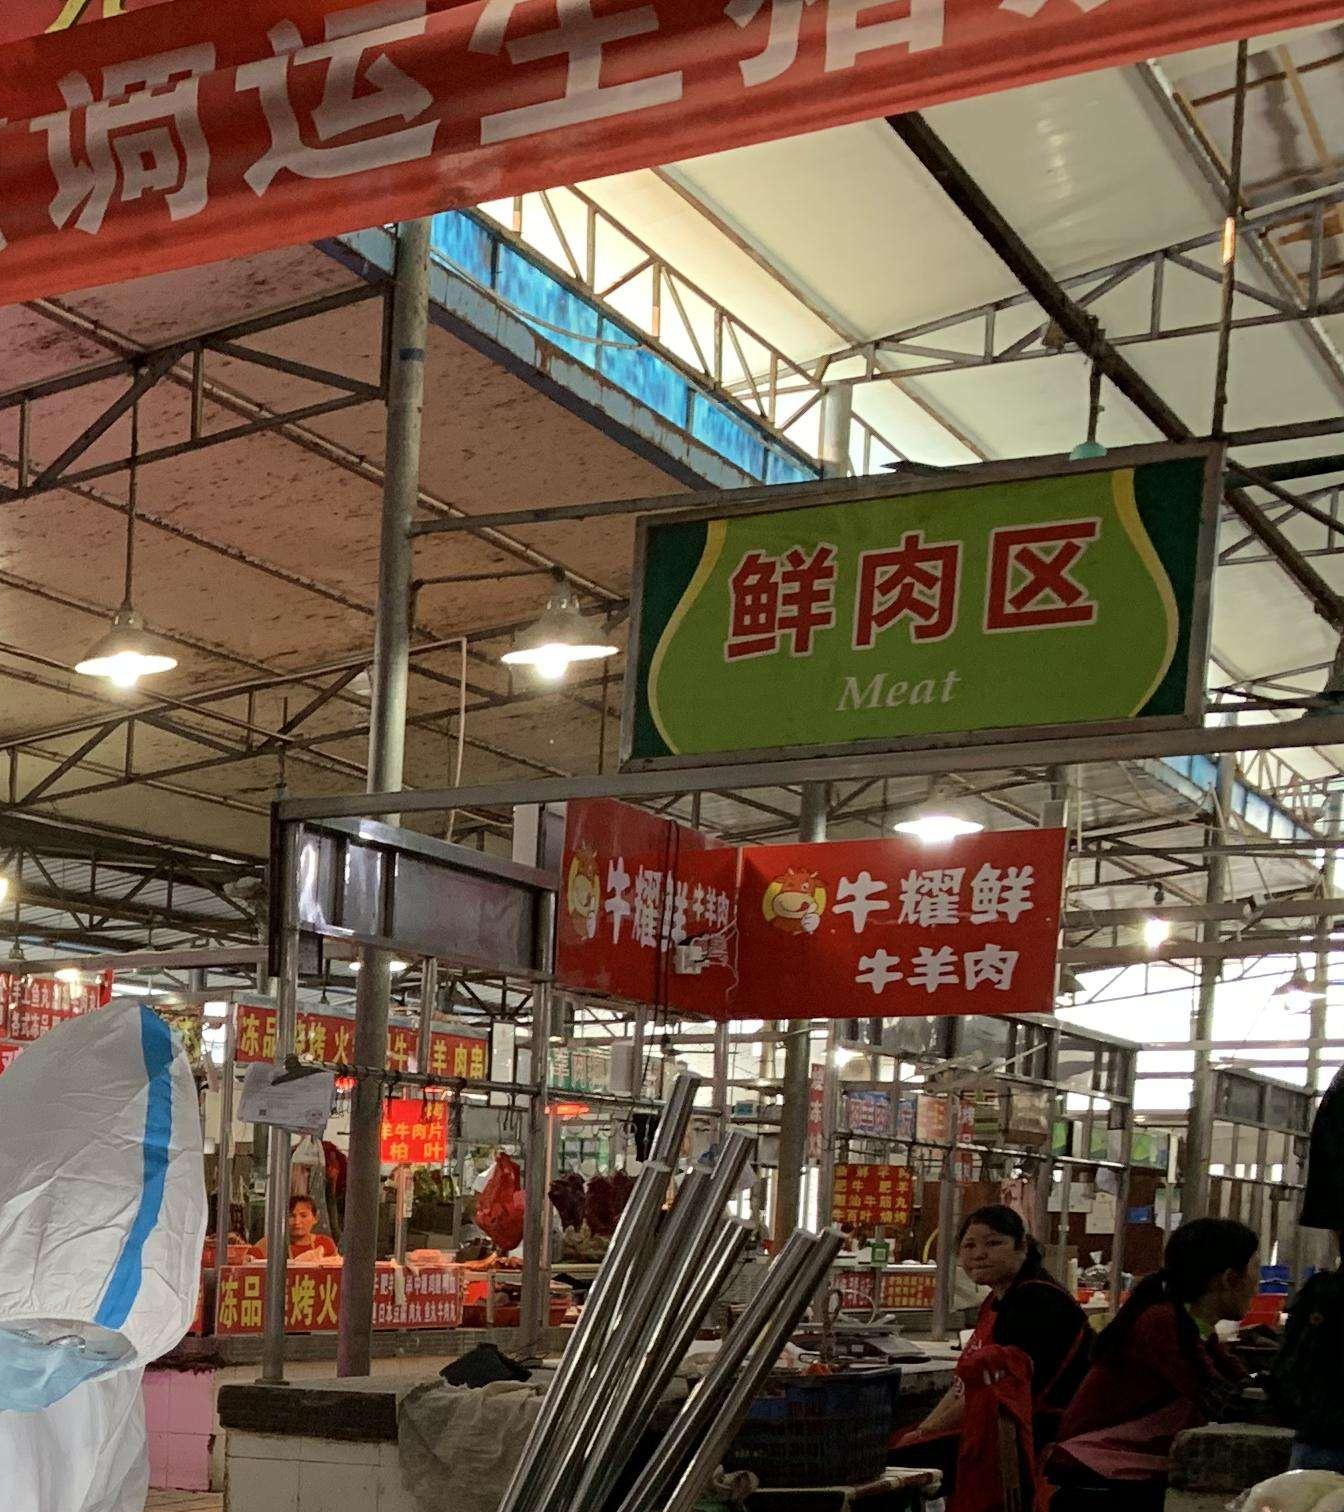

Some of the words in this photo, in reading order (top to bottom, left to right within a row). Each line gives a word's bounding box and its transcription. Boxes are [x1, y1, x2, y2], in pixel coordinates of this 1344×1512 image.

[723, 516, 1103, 664] 鲜肉区
[836, 667, 963, 713] Meat
[835, 861, 1035, 935] 牛耀鲜
[855, 944, 1020, 994] 牛羊肉
[220, 1275, 262, 1328] 冻品
